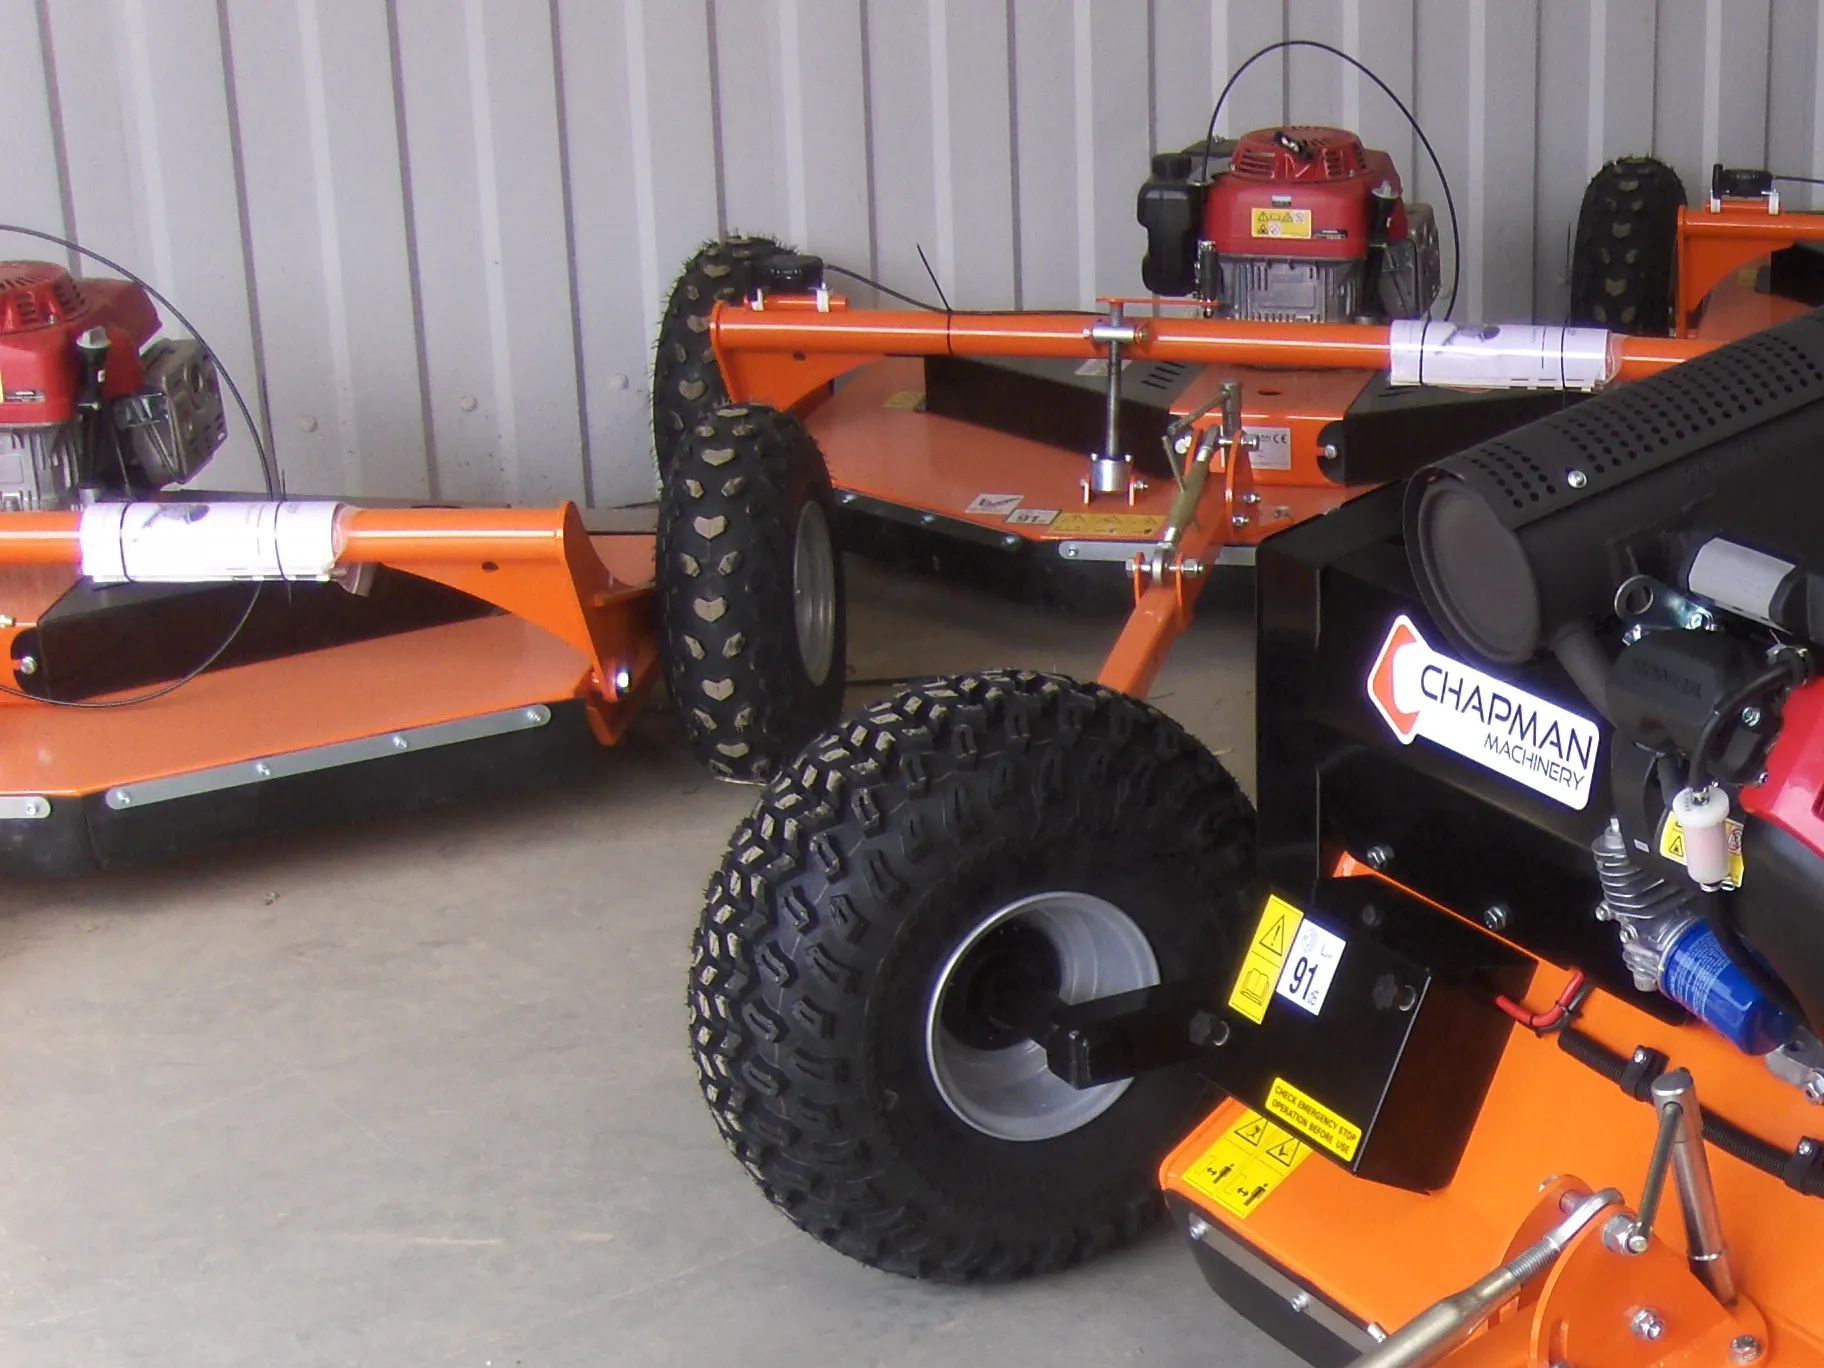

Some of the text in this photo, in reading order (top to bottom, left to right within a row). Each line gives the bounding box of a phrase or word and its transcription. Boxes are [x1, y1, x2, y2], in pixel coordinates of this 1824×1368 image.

[1421, 664, 1592, 770] CHAPMAN
[1484, 732, 1585, 790] MACHINERY
[1289, 956, 1319, 1001] 91
[1272, 1099, 1351, 1155] OPERATION BEFORE USE
[1275, 1085, 1357, 1141] CHECK EMERGENCY STOP
